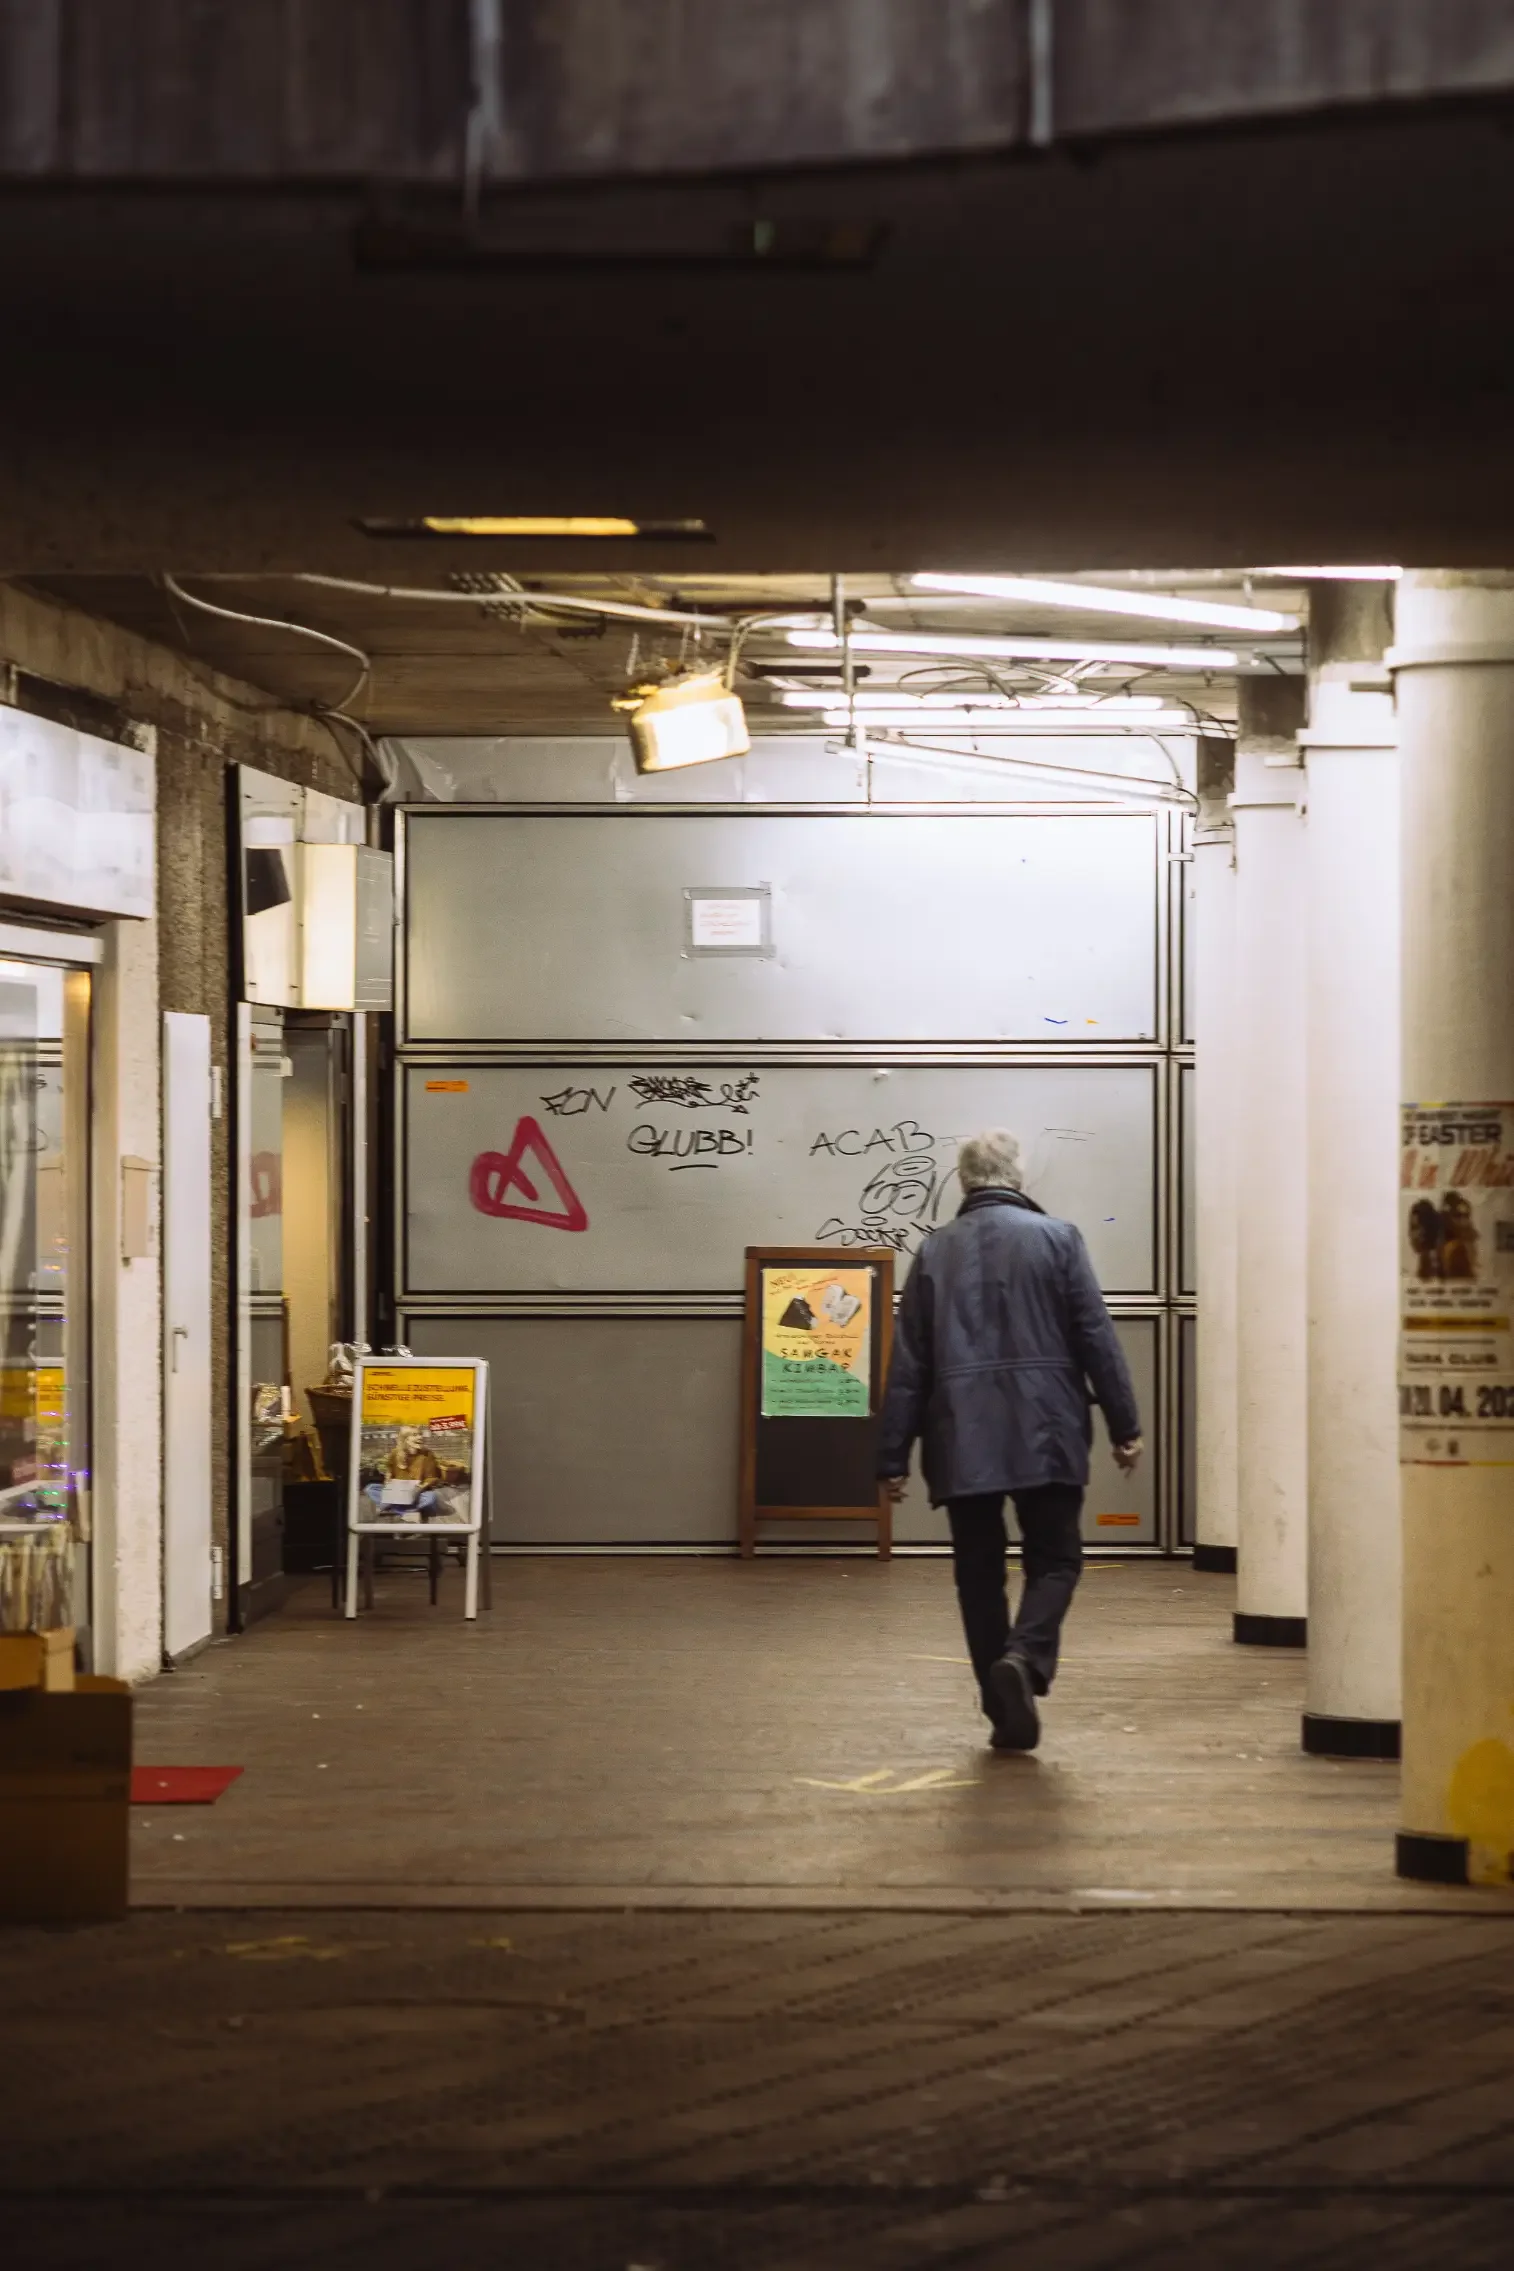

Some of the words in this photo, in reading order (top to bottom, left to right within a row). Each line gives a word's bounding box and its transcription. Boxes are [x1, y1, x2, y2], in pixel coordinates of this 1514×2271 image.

[627, 1124, 754, 1157] GLUBB!
[809, 1120, 935, 1157] ACAB
[1419, 1123, 1503, 1146] EASTER
